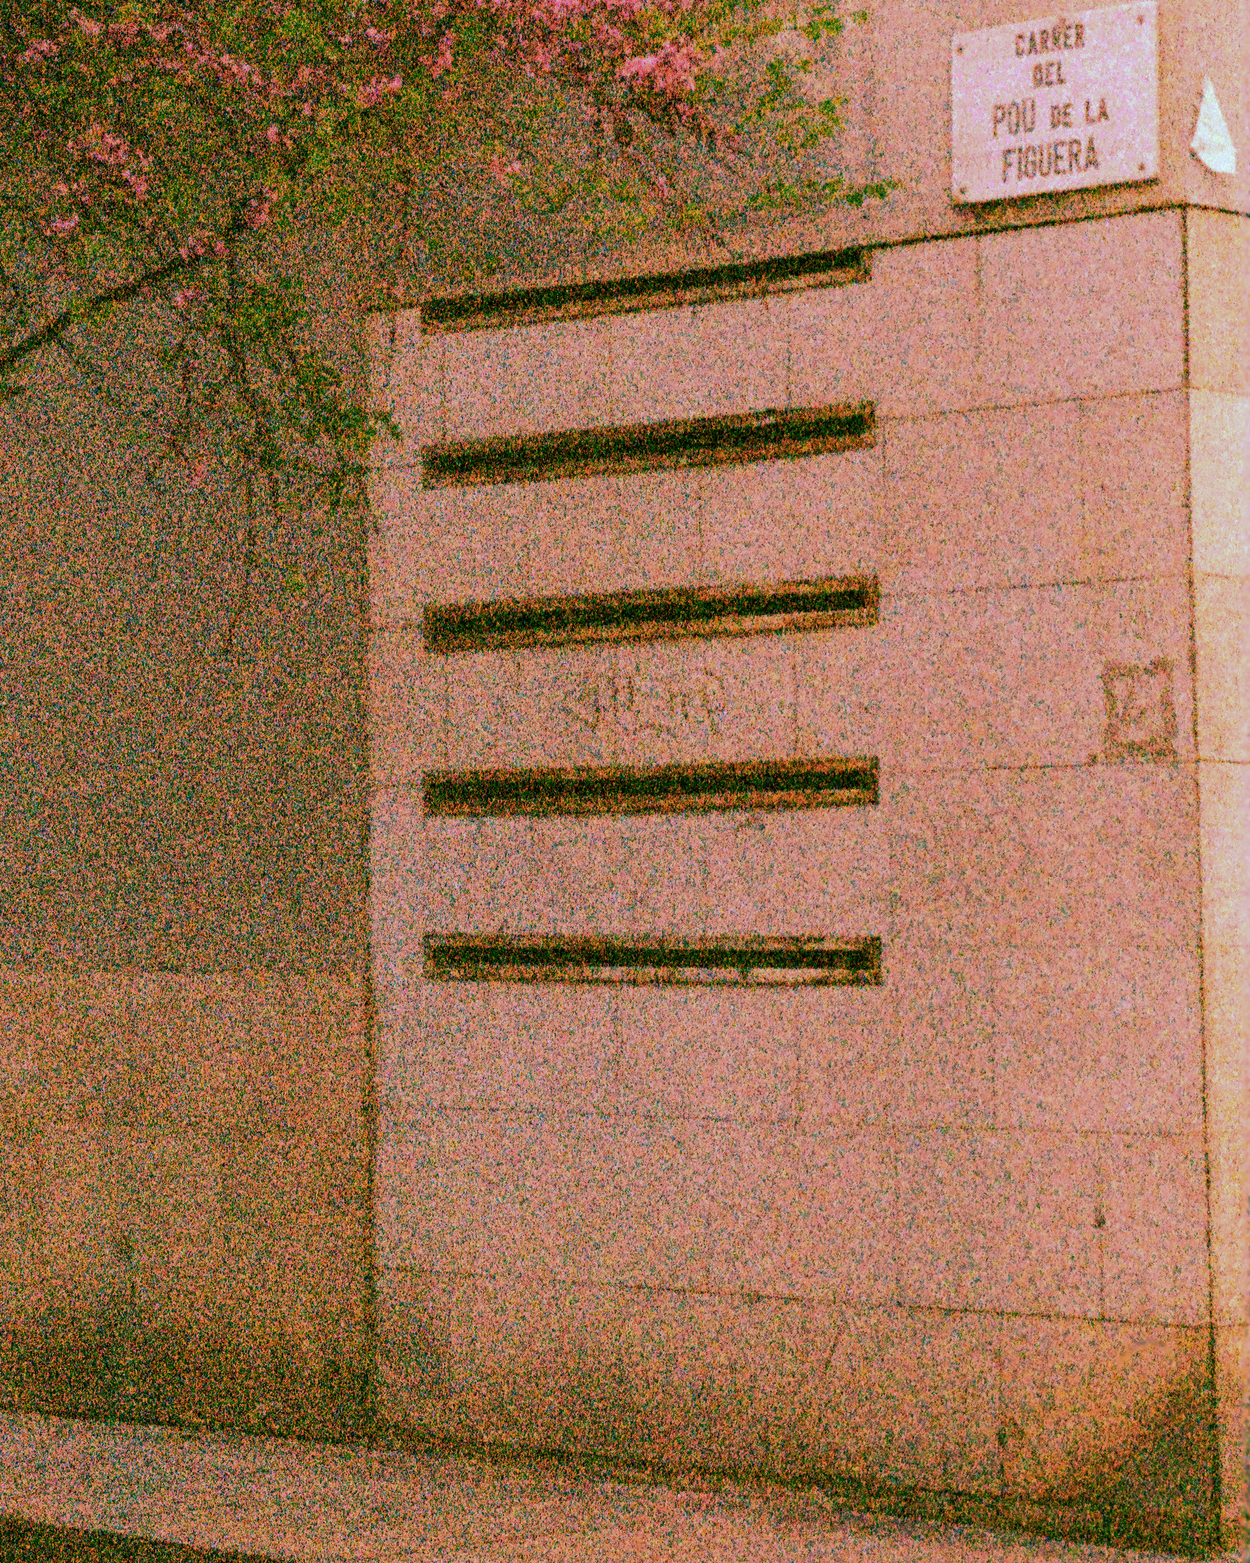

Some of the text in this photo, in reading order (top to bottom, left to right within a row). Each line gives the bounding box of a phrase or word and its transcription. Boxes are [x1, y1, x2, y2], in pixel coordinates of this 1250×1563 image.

[1015, 24, 1085, 57] CARRER
[1034, 61, 1065, 88] DEL
[993, 98, 1109, 138] POU DE LA
[1002, 137, 1100, 183] FIGUERA
